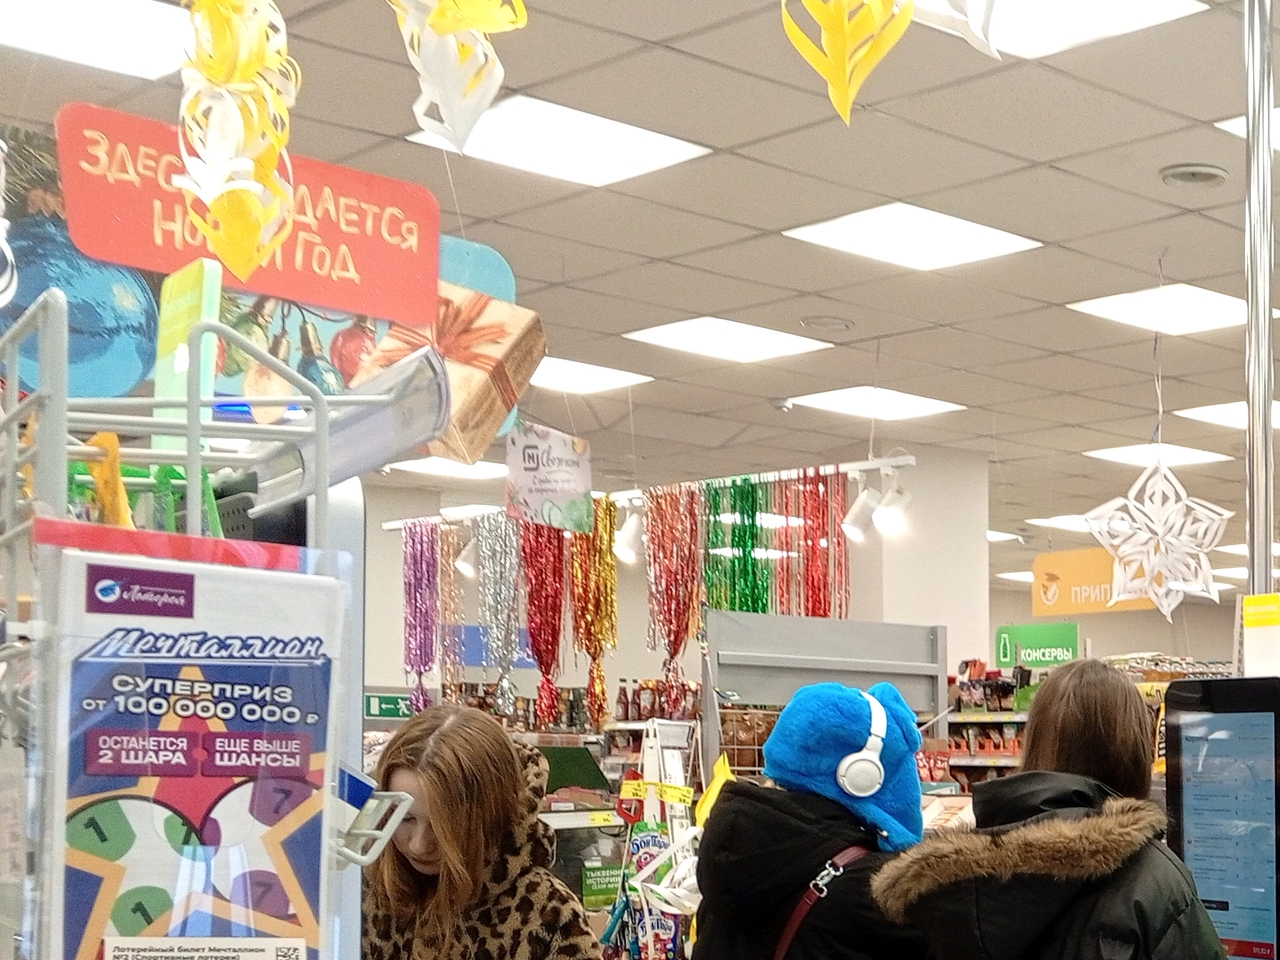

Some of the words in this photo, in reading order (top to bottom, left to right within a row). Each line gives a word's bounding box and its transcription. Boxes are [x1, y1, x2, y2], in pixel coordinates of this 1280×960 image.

[79, 130, 183, 193] ЗДЕС
[1020, 647, 1073, 661] КОНСЕРВЫ
[112, 674, 293, 703] СУПЕРПРИЗ
[115, 695, 169, 715] 100
[175, 699, 237, 720] 000
[242, 702, 301, 724] 000
[98, 736, 187, 751] ОСТАНЕТСЯ
[215, 737, 248, 753] ЕЩЕ
[255, 739, 301, 754] ВЫШЕ
[98, 751, 114, 764] 2
[121, 751, 187, 765] ШАРА
[214, 752, 301, 768] ШАНСЫ
[272, 787, 293, 814] 7
[83, 816, 109, 843] 1
[112, 945, 175, 955] Лотерейный
[177, 945, 206, 954] билет
[208, 946, 266, 954] Мечталлион
